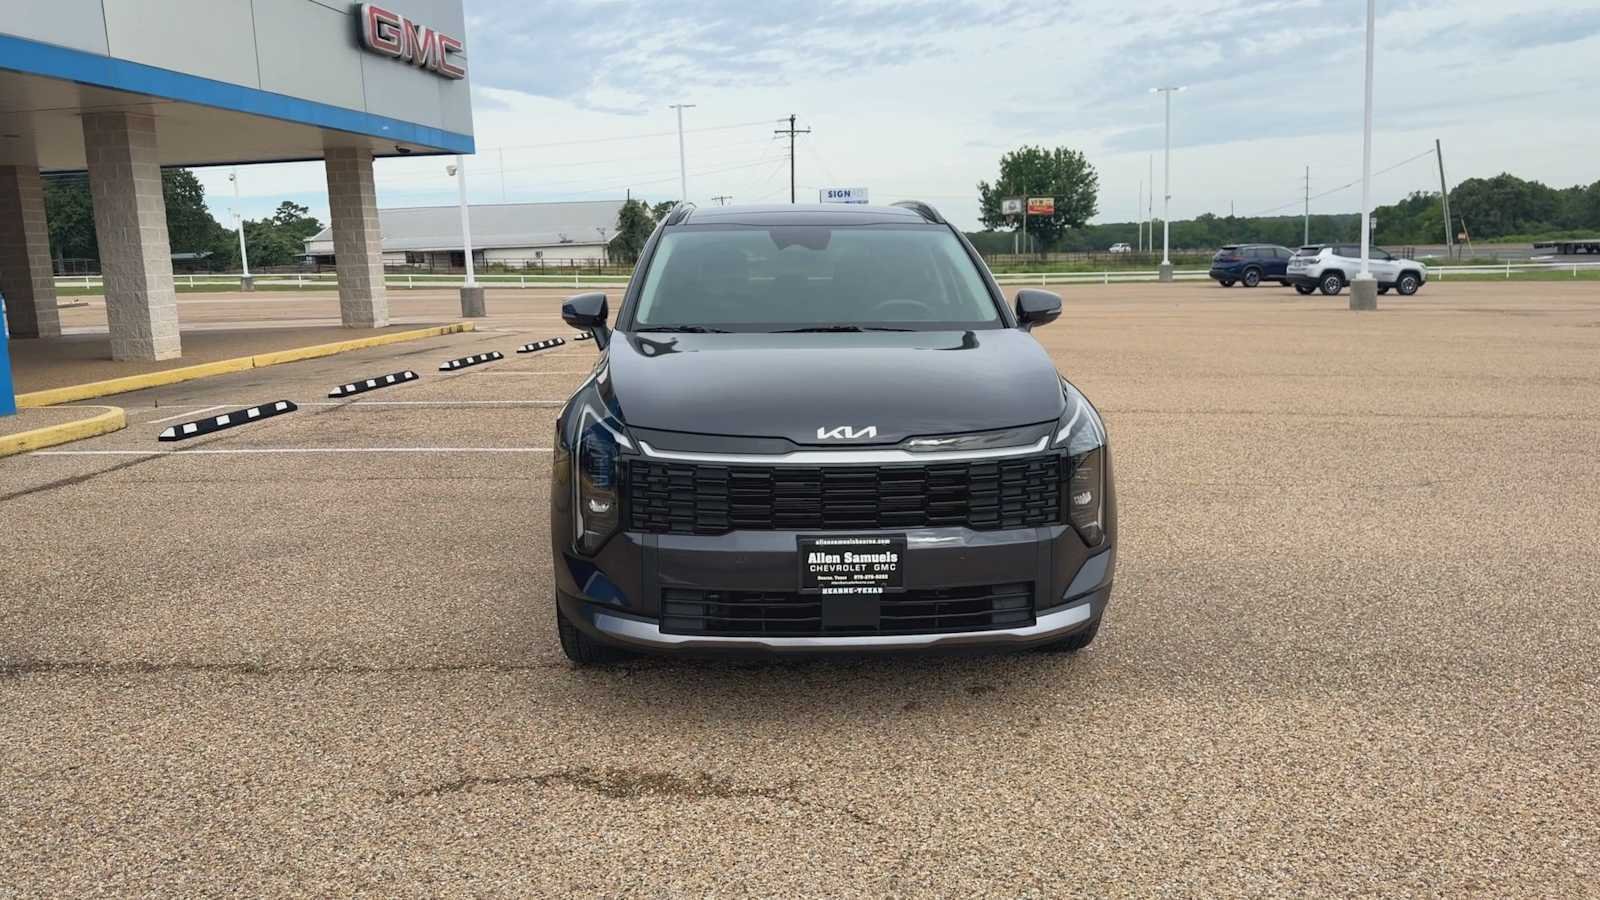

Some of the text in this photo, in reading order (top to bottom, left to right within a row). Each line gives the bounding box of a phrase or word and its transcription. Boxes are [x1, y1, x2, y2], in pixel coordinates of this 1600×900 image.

[360, 2, 465, 80] GMC
[827, 190, 851, 198] SIGN
[816, 425, 877, 439] KIA
[808, 551, 898, 563] Allen Samuels
[810, 563, 896, 572] CHEVROLET GMC
